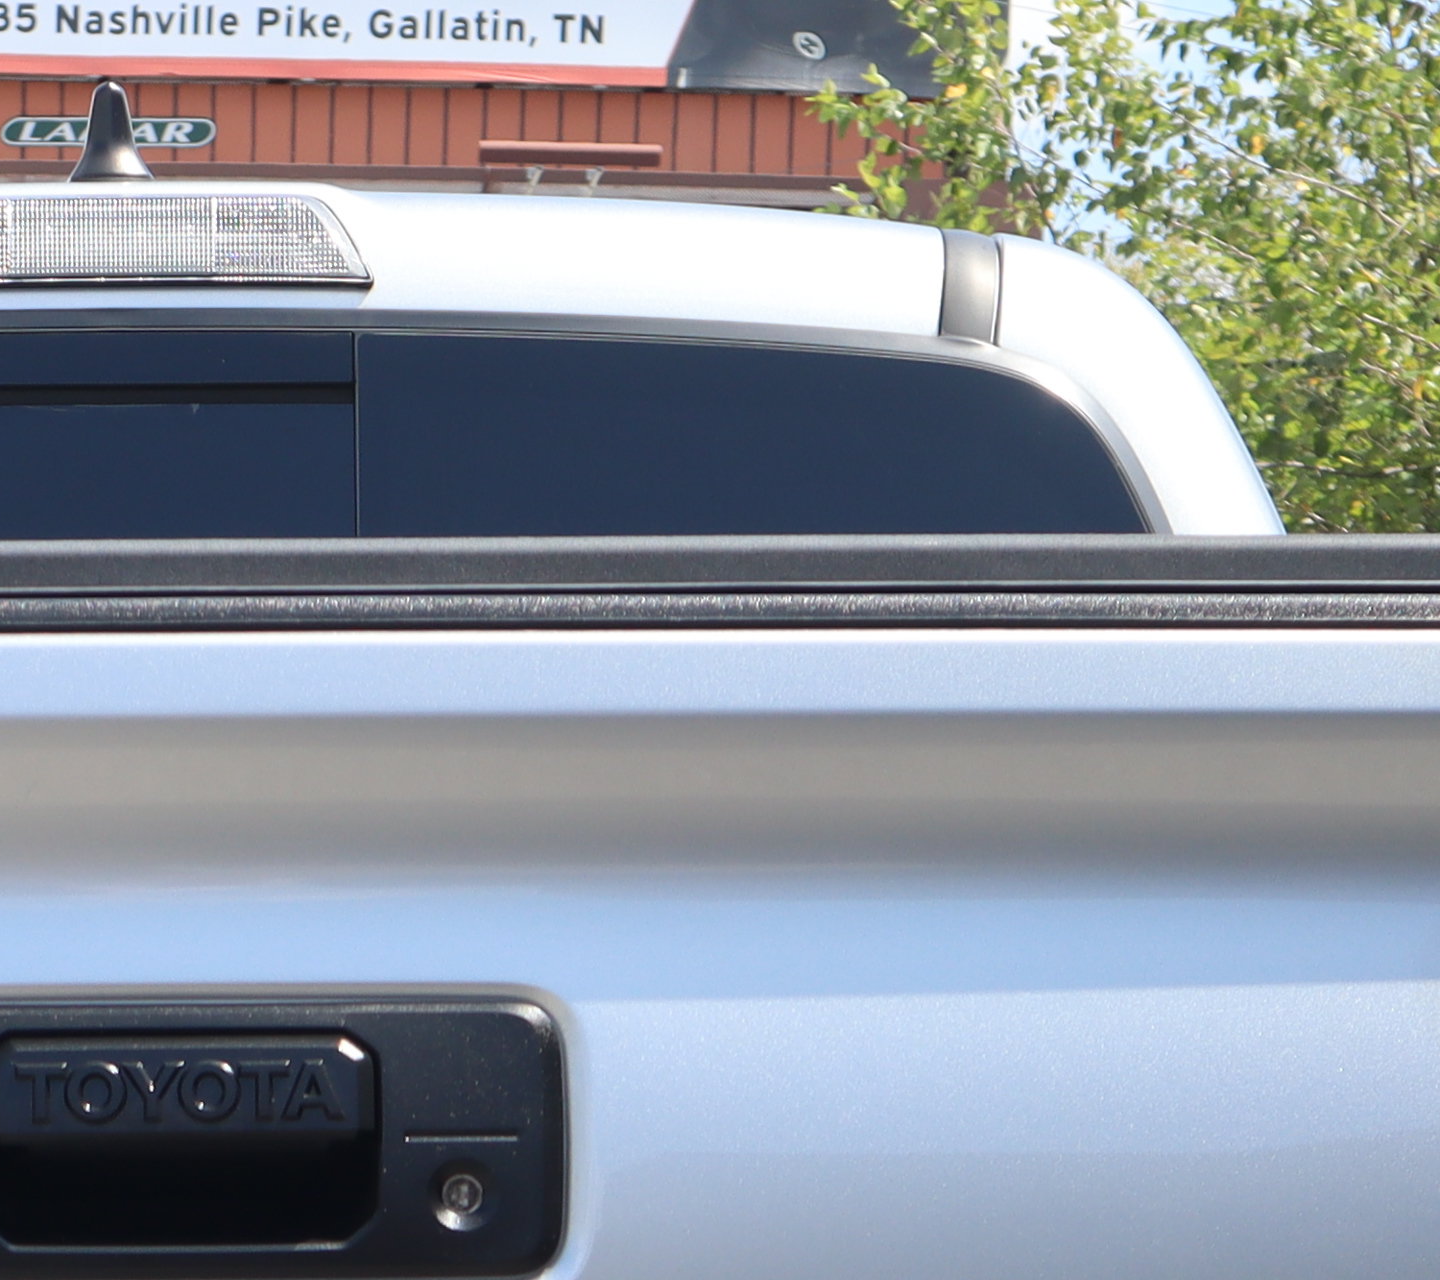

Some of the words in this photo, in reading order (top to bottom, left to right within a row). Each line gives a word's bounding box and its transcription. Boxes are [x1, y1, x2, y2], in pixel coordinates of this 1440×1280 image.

[55, 4, 239, 36] Nashville
[257, 7, 351, 43] Pike,
[369, 9, 537, 47] Gallatin,
[554, 14, 606, 44] TN
[18, 121, 194, 143] LAAR
[12, 1058, 345, 1126] TOYOTA
